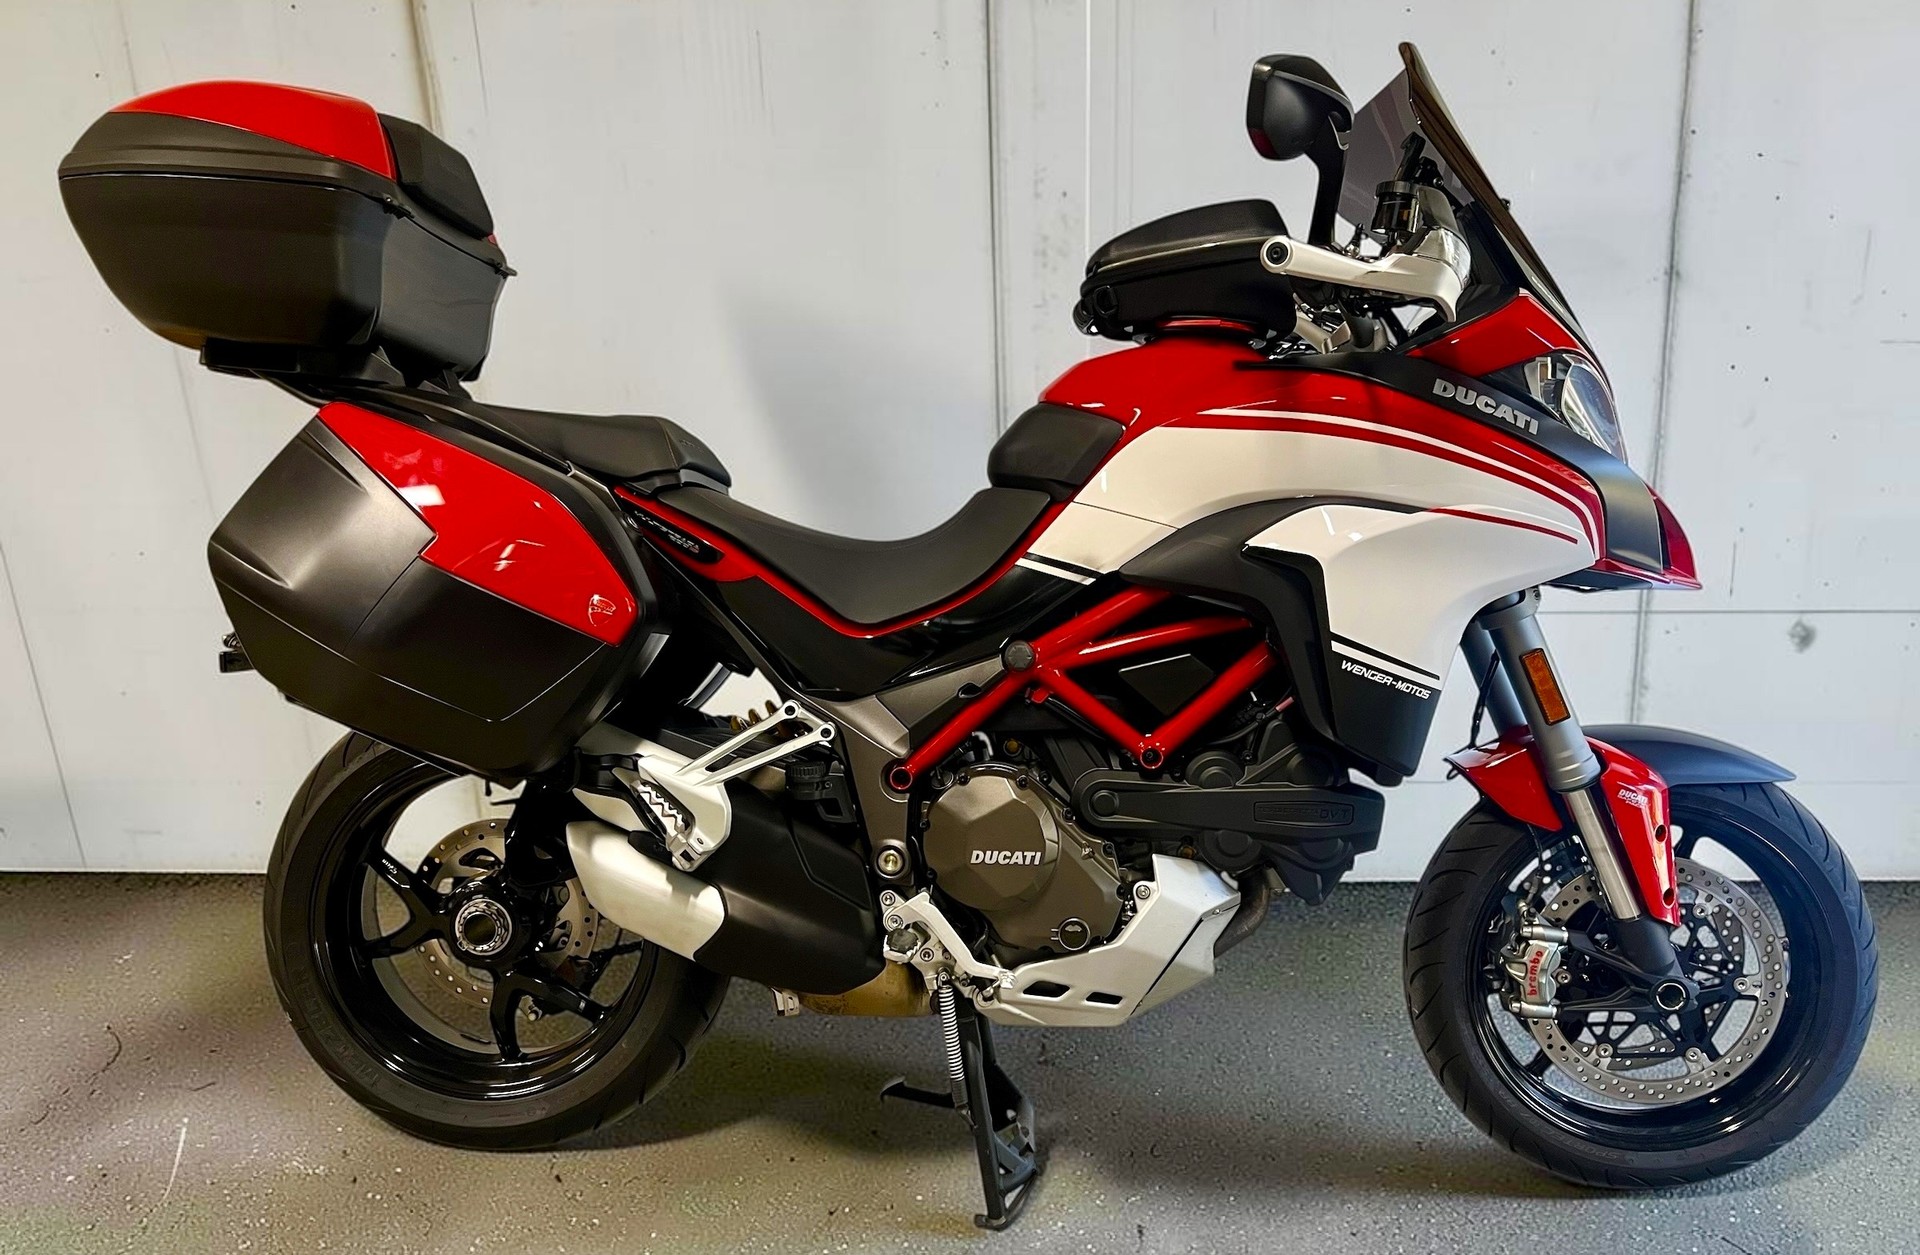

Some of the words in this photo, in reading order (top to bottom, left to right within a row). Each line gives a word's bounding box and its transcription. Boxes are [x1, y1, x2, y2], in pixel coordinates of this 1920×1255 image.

[1432, 378, 1539, 435] DUCATI
[1341, 659, 1432, 699] WENGER-MOTOS
[970, 850, 1042, 865] DUCATI
[1527, 950, 1544, 996] brembo
